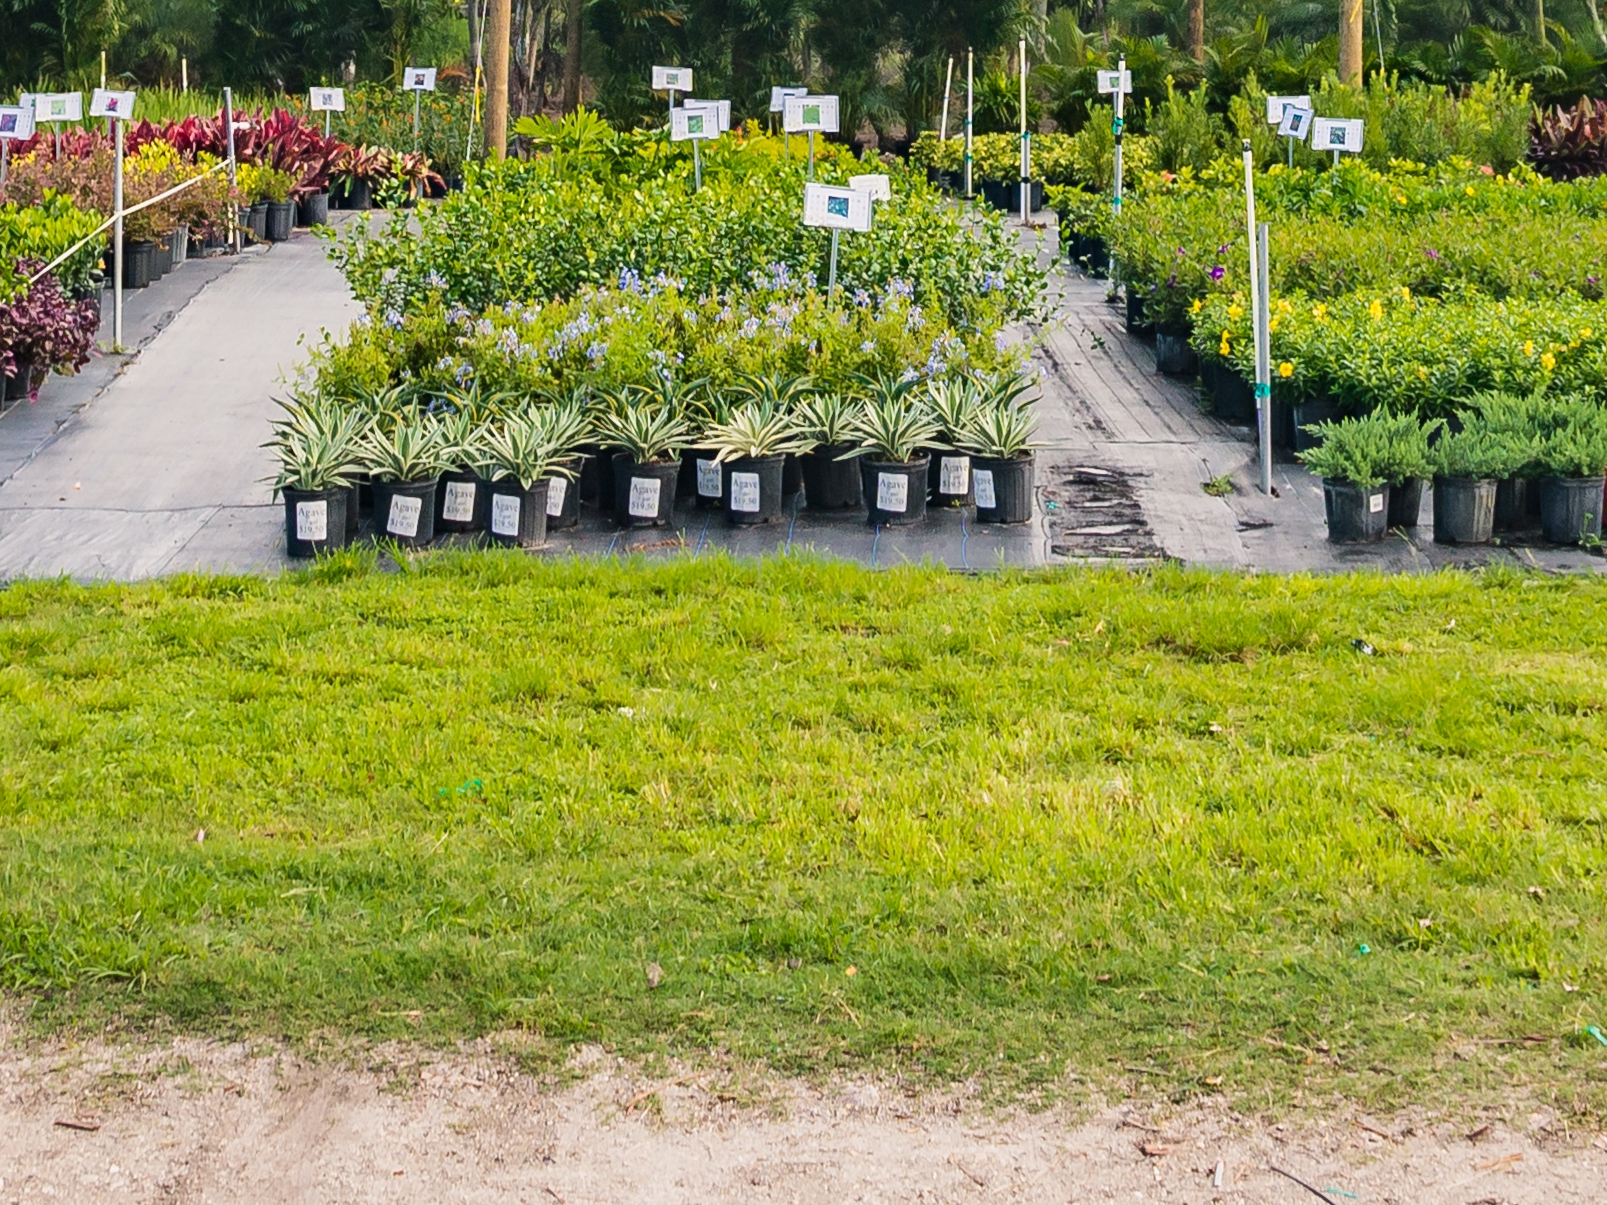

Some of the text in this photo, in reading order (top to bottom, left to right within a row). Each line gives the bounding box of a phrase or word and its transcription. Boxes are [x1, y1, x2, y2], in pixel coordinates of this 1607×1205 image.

[698, 465, 720, 476] Agave
[942, 462, 969, 474] Agave
[632, 483, 658, 495] Agave
[733, 478, 758, 489] Agave
[880, 478, 905, 490] Agave
[447, 488, 473, 499] Agave
[734, 496, 757, 505] $19.50
[880, 496, 904, 506] $19.50
[392, 500, 419, 514] Agave
[494, 500, 518, 513] Agave
[631, 502, 656, 511] $19.50
[298, 507, 325, 518] Agave
[390, 518, 415, 529] $19.50
[494, 518, 517, 529] $19.50
[299, 525, 324, 534] $19.50
